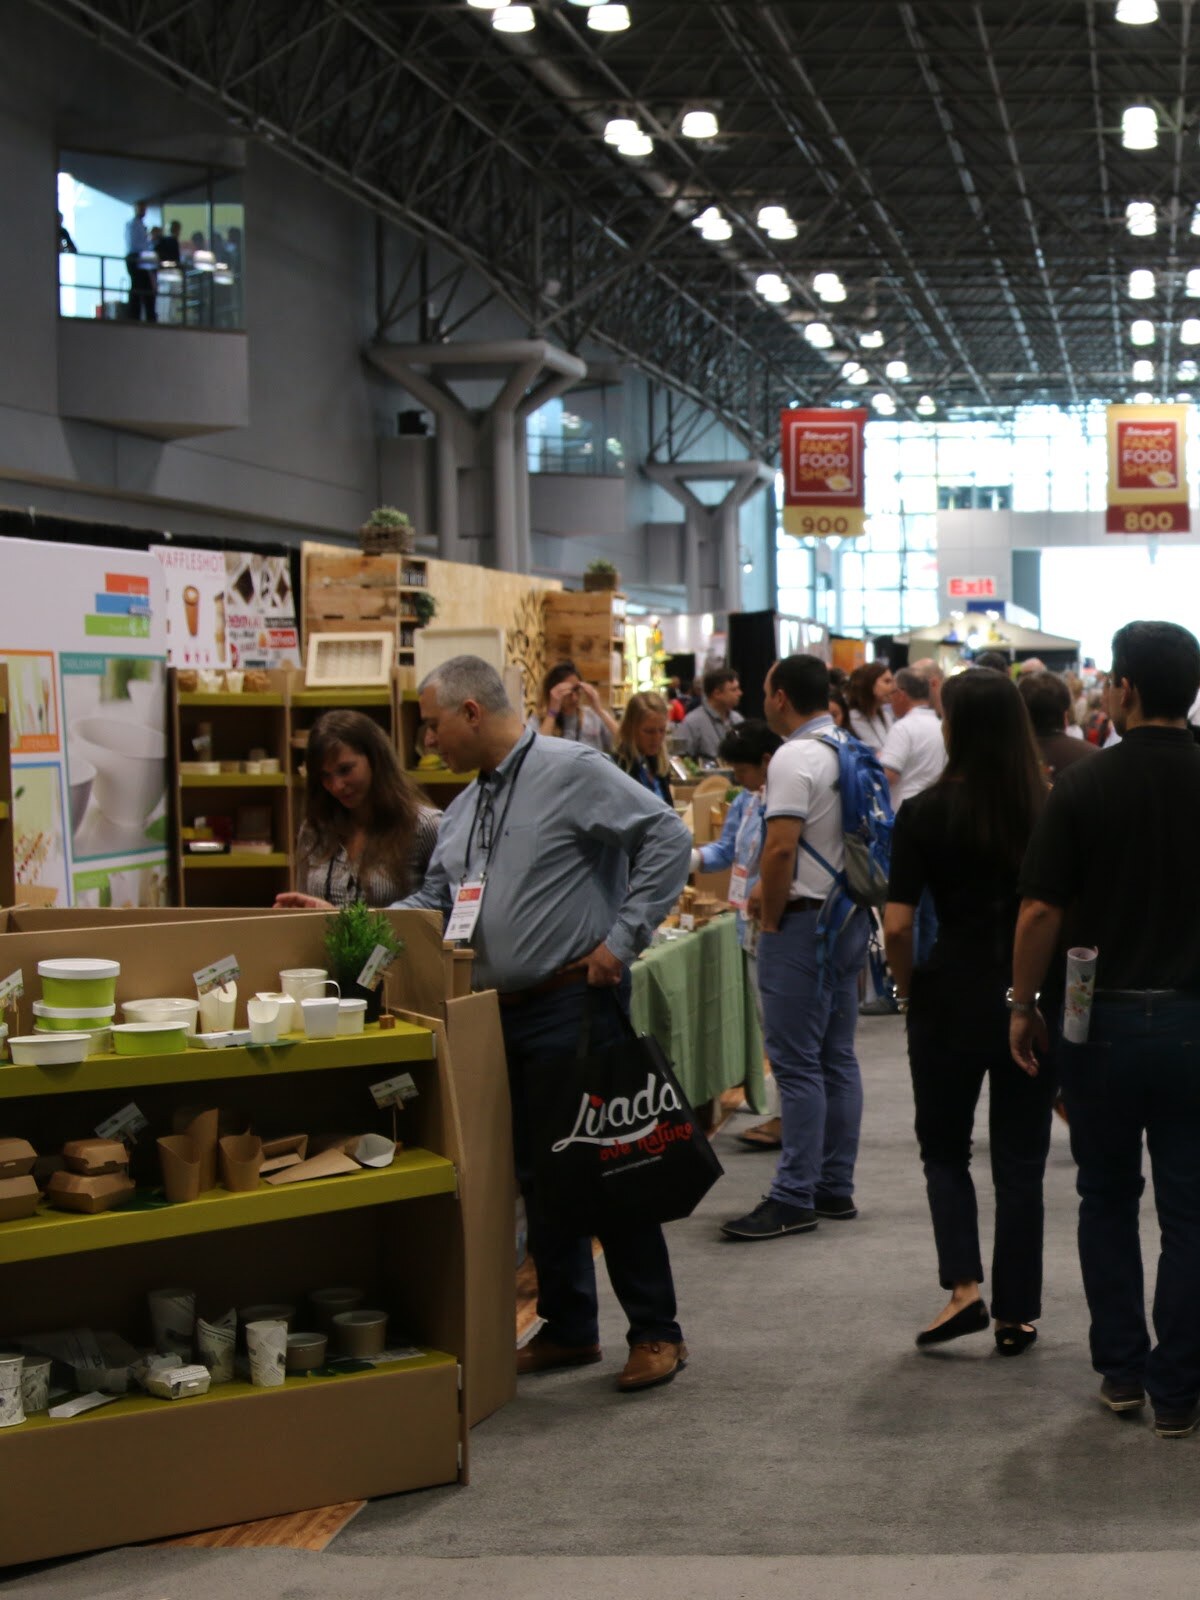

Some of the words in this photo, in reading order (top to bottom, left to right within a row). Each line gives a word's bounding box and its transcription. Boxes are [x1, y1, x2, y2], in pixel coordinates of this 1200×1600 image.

[800, 440, 848, 453] FANCY
[1123, 436, 1172, 448] FANCY
[800, 453, 849, 468] FOOD
[1123, 449, 1172, 463] FOOD
[800, 467, 848, 480] SHOW
[1124, 463, 1172, 476] SHOW
[802, 516, 848, 534] 900
[1125, 511, 1173, 531] 800
[949, 578, 994, 597] Exit
[637, 1120, 693, 1154] nature
